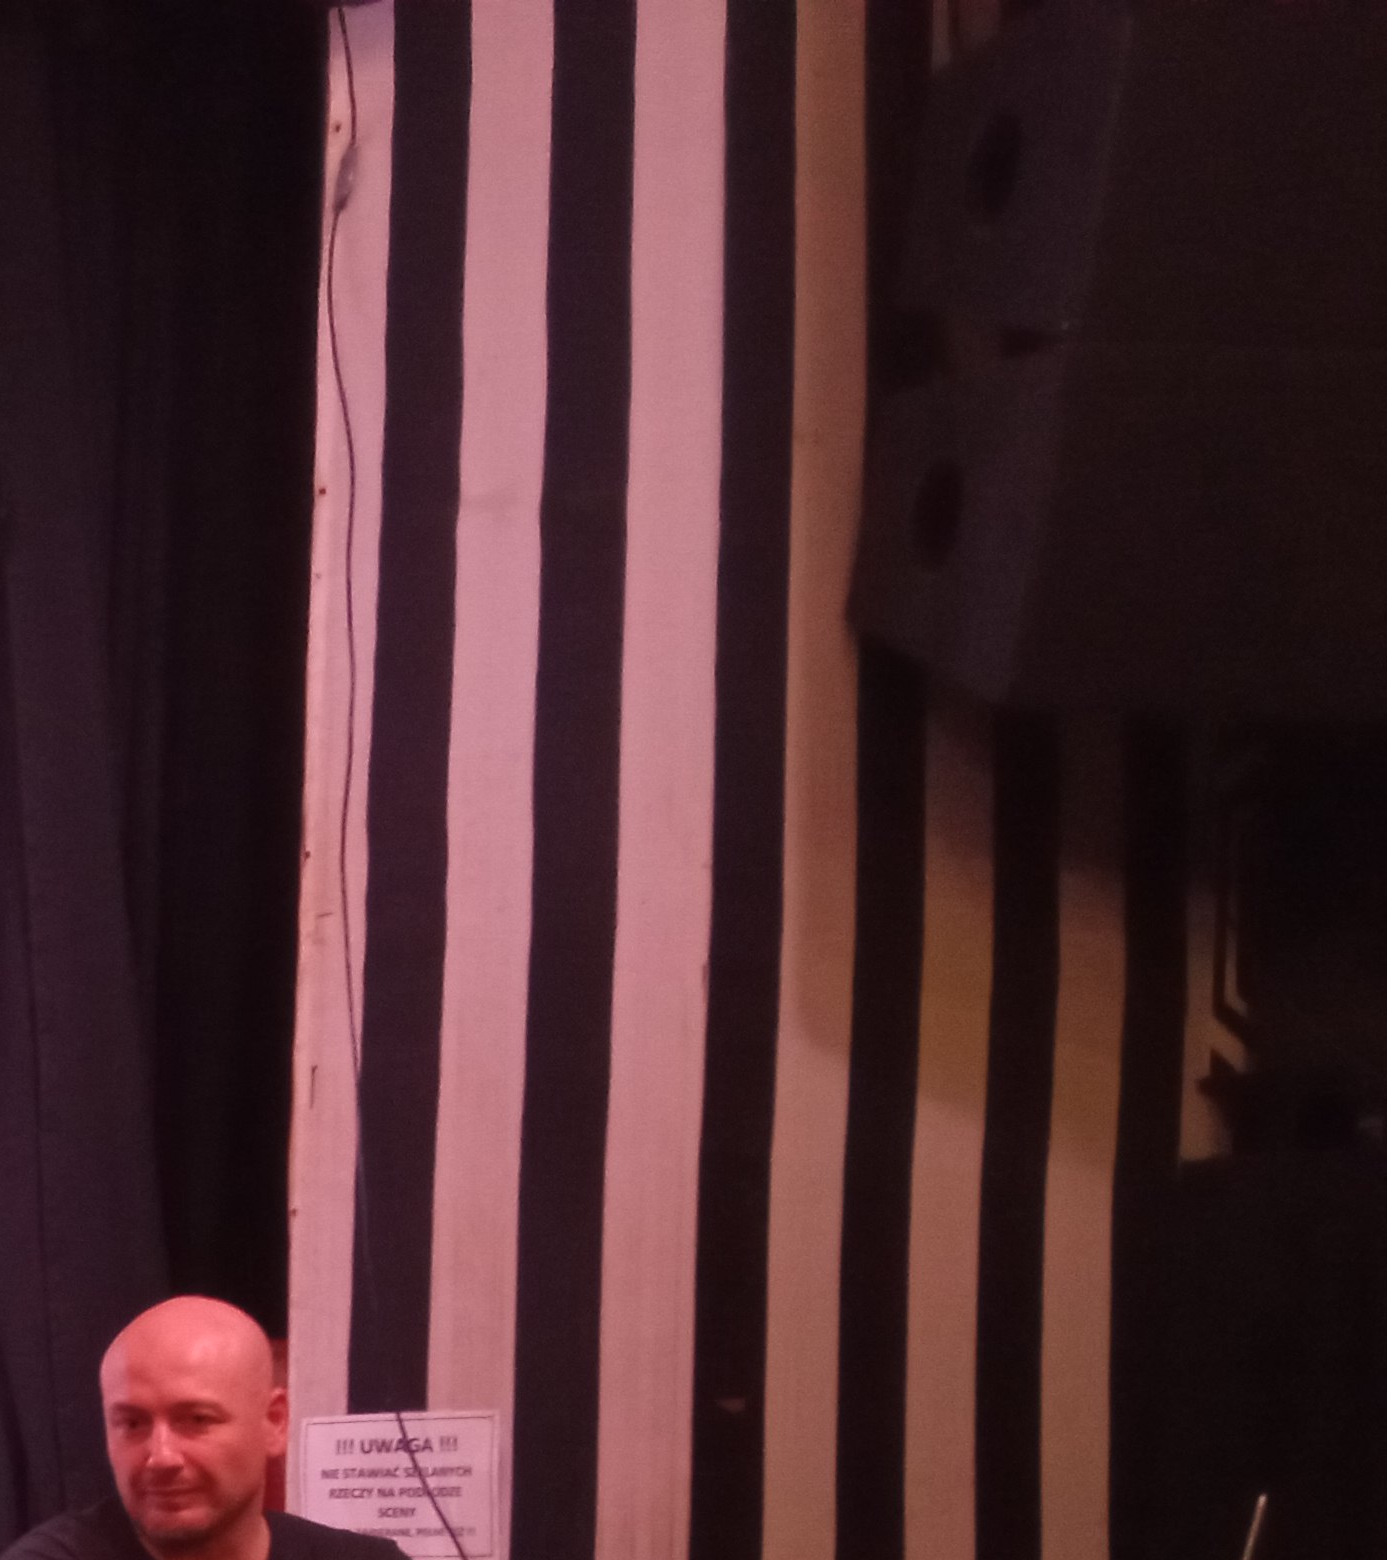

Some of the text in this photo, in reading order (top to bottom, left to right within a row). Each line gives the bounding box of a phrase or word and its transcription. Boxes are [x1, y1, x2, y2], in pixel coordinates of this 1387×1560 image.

[360, 1437, 433, 1453] UWAGA
[321, 1468, 339, 1479] NIE
[329, 1486, 462, 1498] RZECZY NA PODODZE
[378, 1507, 415, 1517] SCENY
